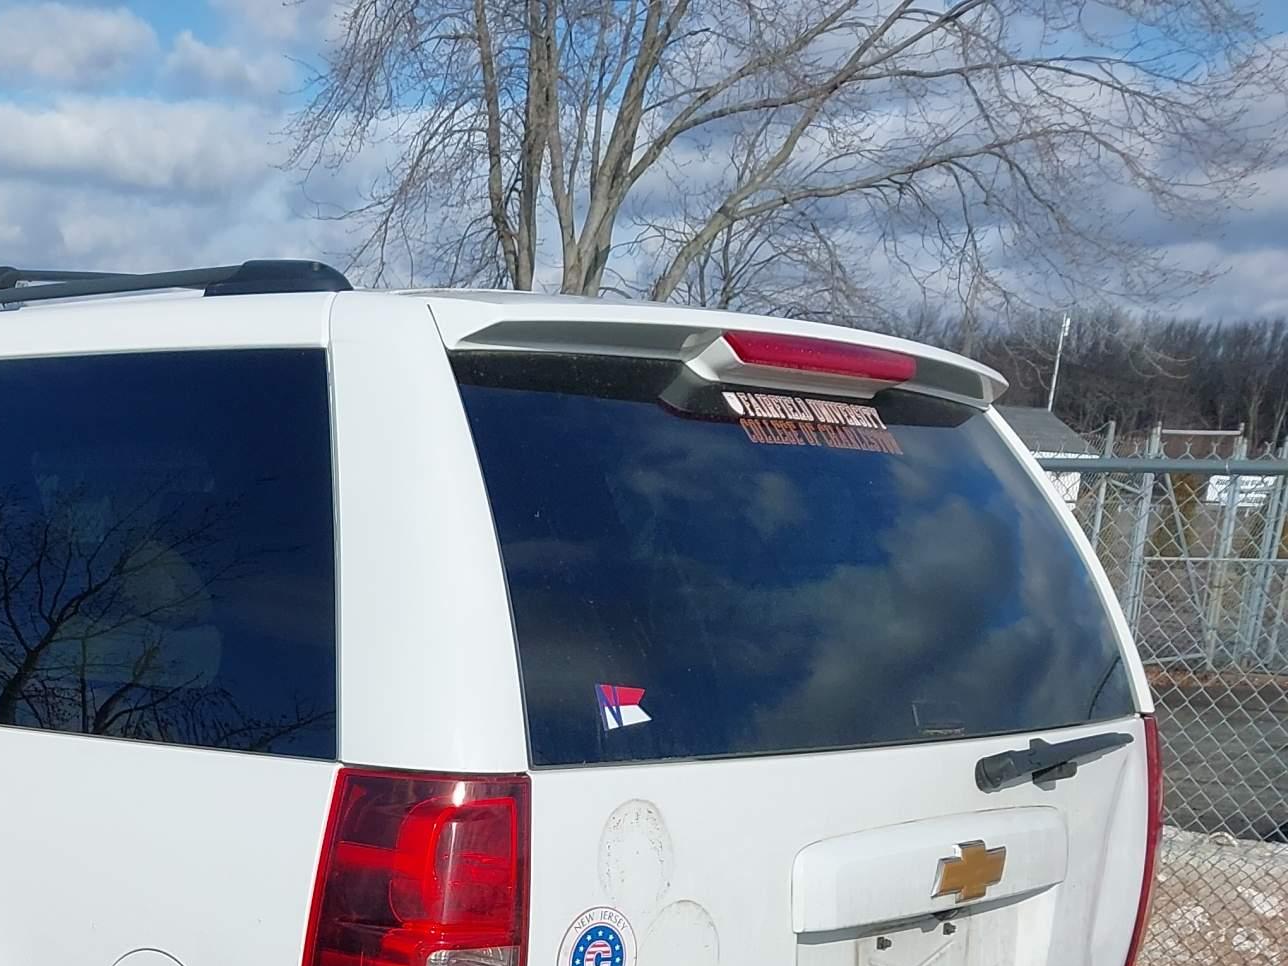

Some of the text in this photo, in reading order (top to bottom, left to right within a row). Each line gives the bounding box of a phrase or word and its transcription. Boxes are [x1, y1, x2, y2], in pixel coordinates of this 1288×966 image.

[737, 392, 887, 430] FAIRFIELD UNIVERSITY
[739, 418, 904, 455] COLLEGE OF CHARLESTON
[574, 910, 629, 933] NEW JERSEY
